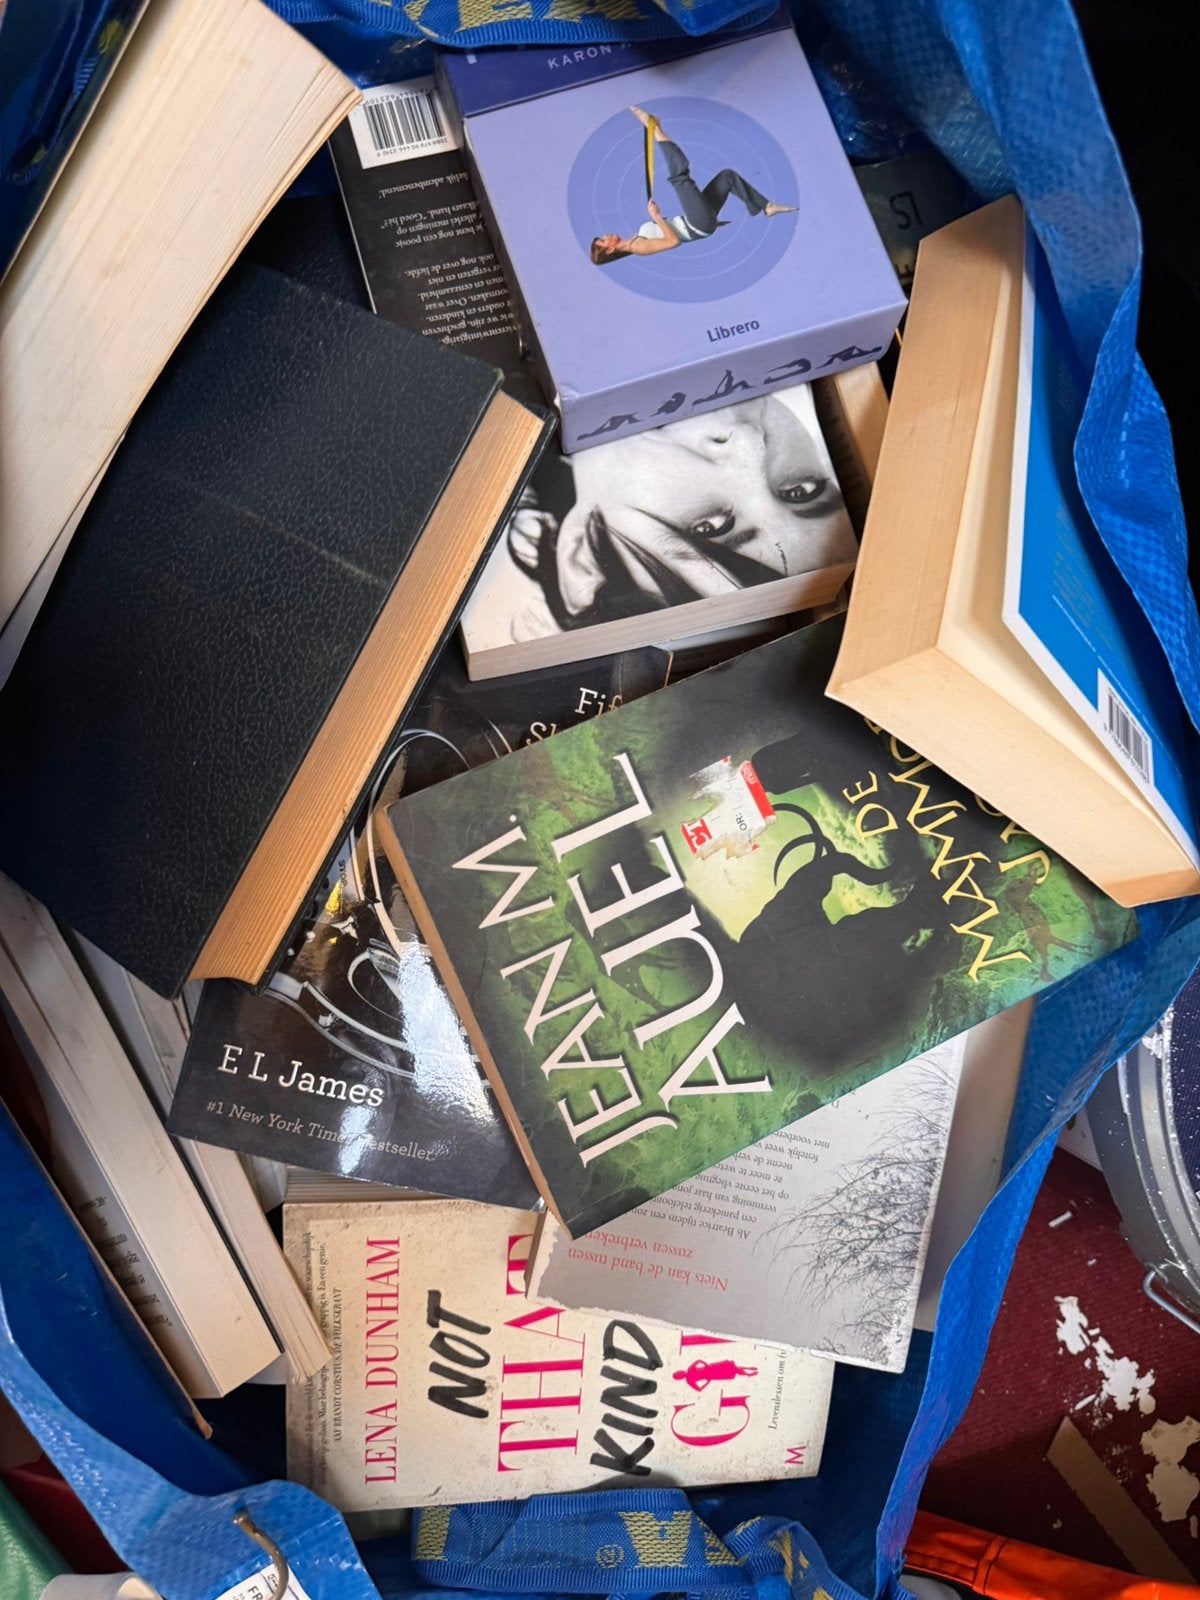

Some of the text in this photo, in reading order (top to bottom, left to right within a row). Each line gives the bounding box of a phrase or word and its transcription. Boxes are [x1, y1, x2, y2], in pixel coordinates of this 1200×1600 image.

[548, 44, 612, 69] KARON
[426, 206, 451, 218] hand.
[408, 216, 449, 233] meningen
[449, 213, 477, 226] allerlei
[395, 225, 407, 235] op
[437, 228, 454, 239] nog
[455, 226, 475, 237] bent
[394, 234, 422, 249] poosje
[442, 260, 460, 269] over
[459, 255, 476, 266] nog
[403, 266, 430, 280] liefde.
[430, 264, 441, 274] de
[456, 264, 491, 279] vergeten
[427, 276, 444, 285] niet
[445, 273, 456, 281] en
[473, 280, 484, 288] en
[417, 282, 473, 302] eenzaamheid.
[424, 300, 444, 310] waar
[445, 296, 467, 309] Over
[477, 301, 505, 314] ouders
[425, 309, 465, 325] kinderen.
[486, 315, 498, 323] we
[421, 319, 466, 339] geschreven
[707, 320, 760, 342] Librero
[842, 770, 899, 841] DE
[551, 753, 773, 1112] AUEL
[452, 814, 678, 1168] JEAN M.
[218, 1043, 385, 1108] E L James
[206, 1099, 437, 1162] #1 New York Time estseller
[764, 1143, 784, 1153] weet
[813, 1139, 830, 1149] niet
[752, 1155, 763, 1165] de
[786, 1146, 819, 1163] feitelijk
[765, 1158, 792, 1170] neemt
[737, 1167, 747, 1176] te
[748, 1169, 771, 1180] meer
[773, 1174, 782, 1182] ze
[733, 1181, 759, 1193] eerste
[761, 1187, 775, 1197] het
[777, 1188, 789, 1199] op
[693, 1188, 712, 1200] haar
[714, 1192, 729, 1202] van
[731, 1193, 777, 1213] vermissing
[649, 1210, 666, 1219] een
[692, 1201, 739, 1220] paniekerig
[667, 1211, 697, 1228] tijdens
[740, 1213, 757, 1223] een
[698, 1220, 734, 1236] Beatrice
[735, 1227, 750, 1238] Als
[651, 1241, 694, 1260] zussen
[566, 1247, 728, 1291] Niets kan de band tussen
[331, 1286, 343, 1340] VOLKSKRANT
[333, 1342, 341, 1353] DE
[427, 1289, 492, 1419] NOT
[365, 1236, 400, 1485] LENA DUNHAM
[590, 1319, 663, 1476] KIND
[767, 1375, 783, 1429] Levenslessen
[777, 1360, 785, 1374] om
[332, 1396, 342, 1426] BRANDT
